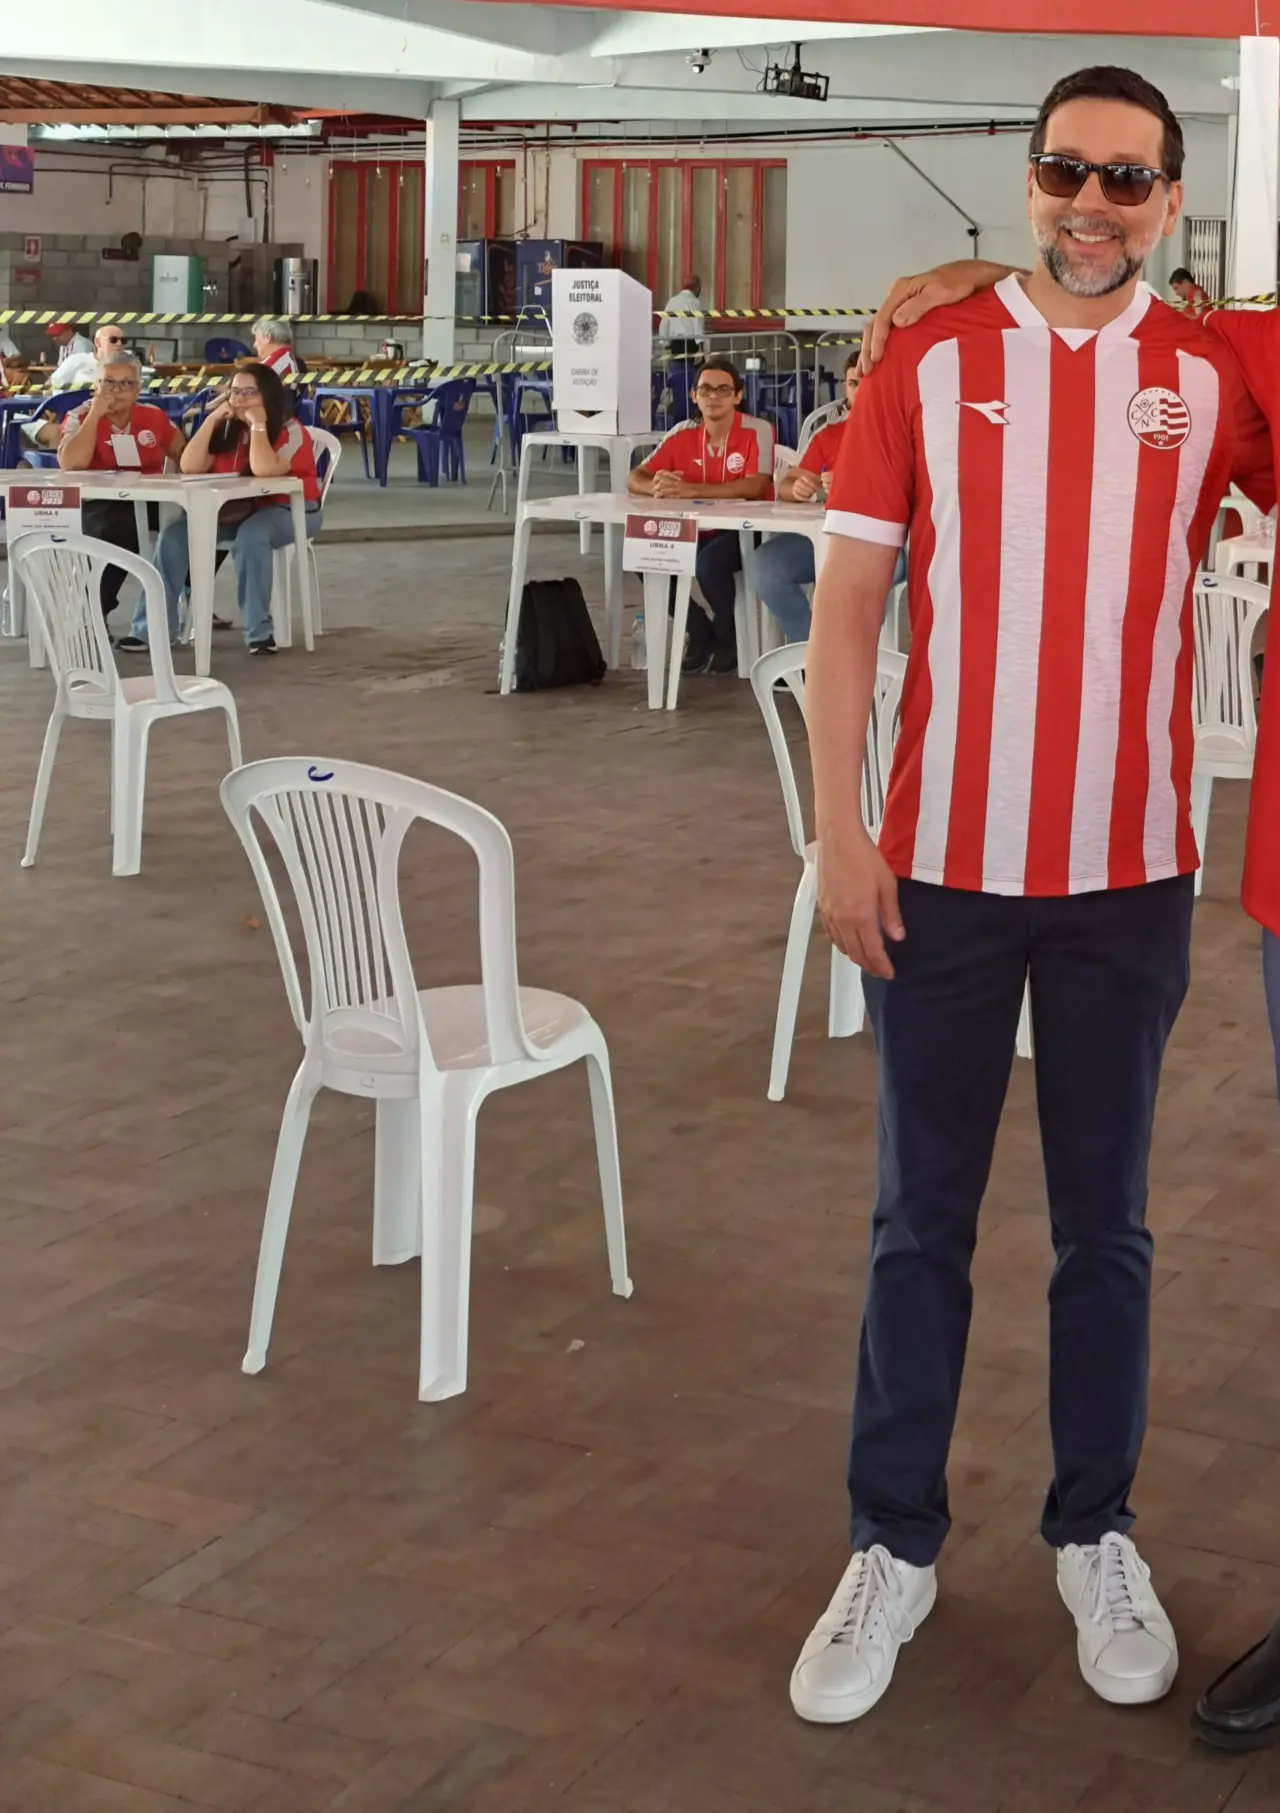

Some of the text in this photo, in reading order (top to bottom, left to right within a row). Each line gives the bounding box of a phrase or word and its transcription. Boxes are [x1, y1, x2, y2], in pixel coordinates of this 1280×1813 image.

[572, 280, 599, 291] JUSTIÇA
[569, 293, 603, 302] ELEITORAL
[1153, 433, 1169, 442] 1901
